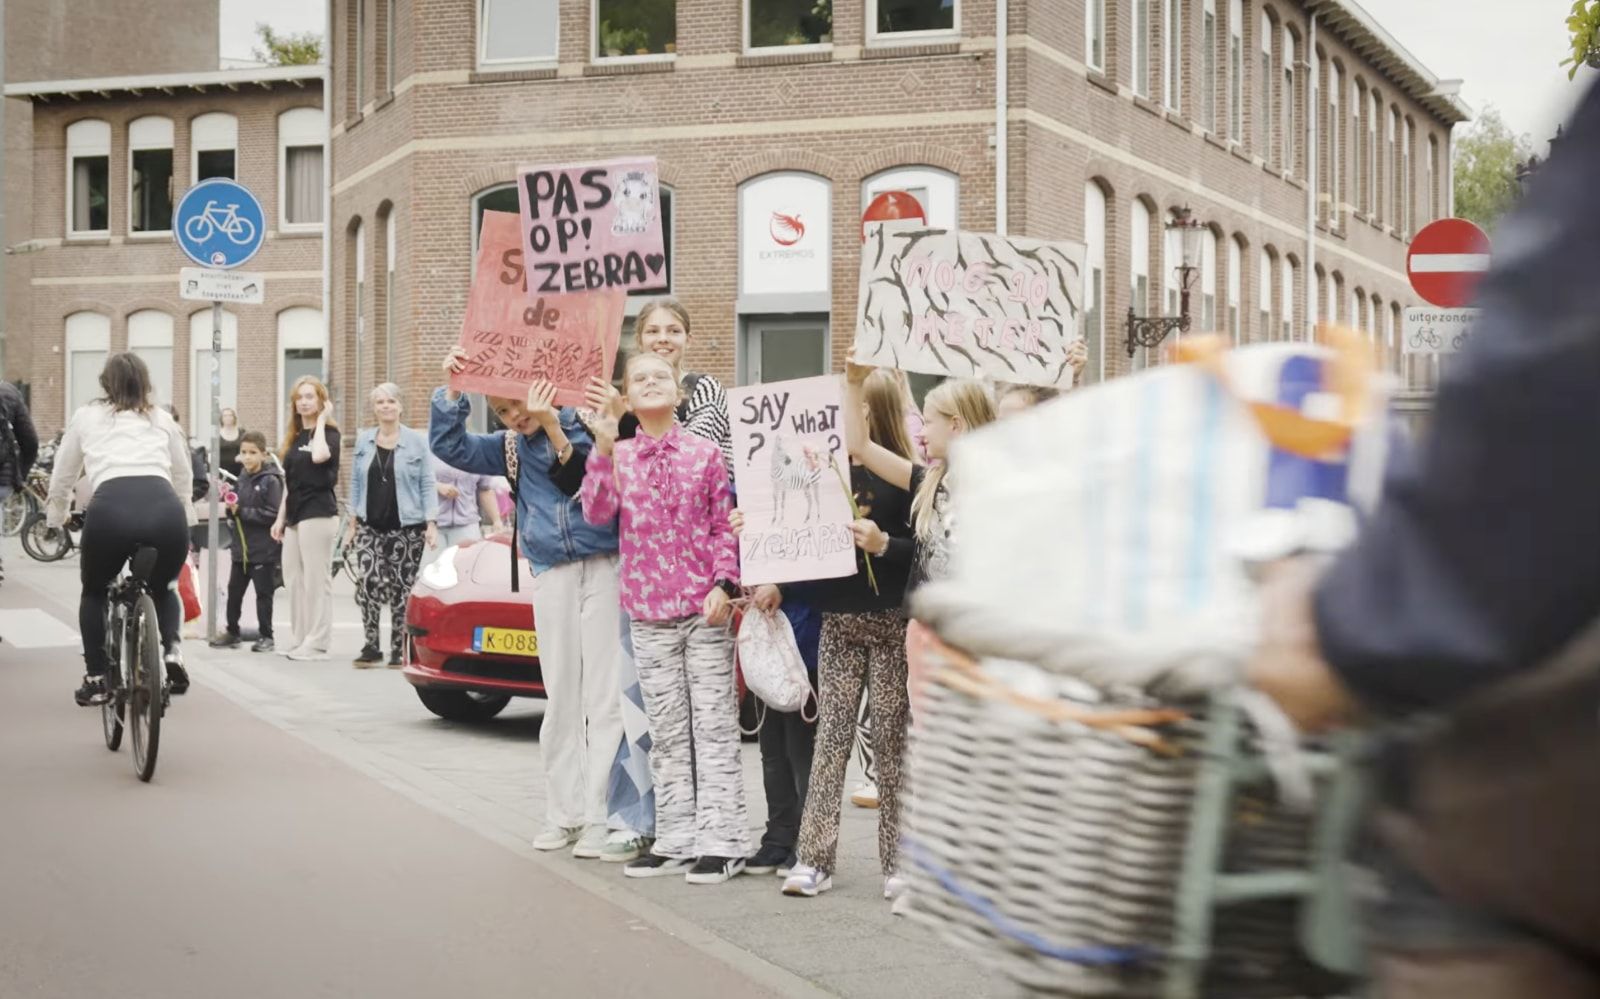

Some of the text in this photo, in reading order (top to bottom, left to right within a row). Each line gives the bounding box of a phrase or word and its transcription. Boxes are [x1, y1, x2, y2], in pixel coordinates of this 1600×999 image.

[525, 169, 612, 219] PAS
[530, 217, 592, 254] OP!
[534, 251, 647, 292] ZEBRA
[759, 250, 815, 260] EXTREMOS
[1008, 271, 1050, 307] 10
[523, 297, 560, 331] de
[913, 312, 1044, 354] METER
[740, 392, 790, 431] SAY
